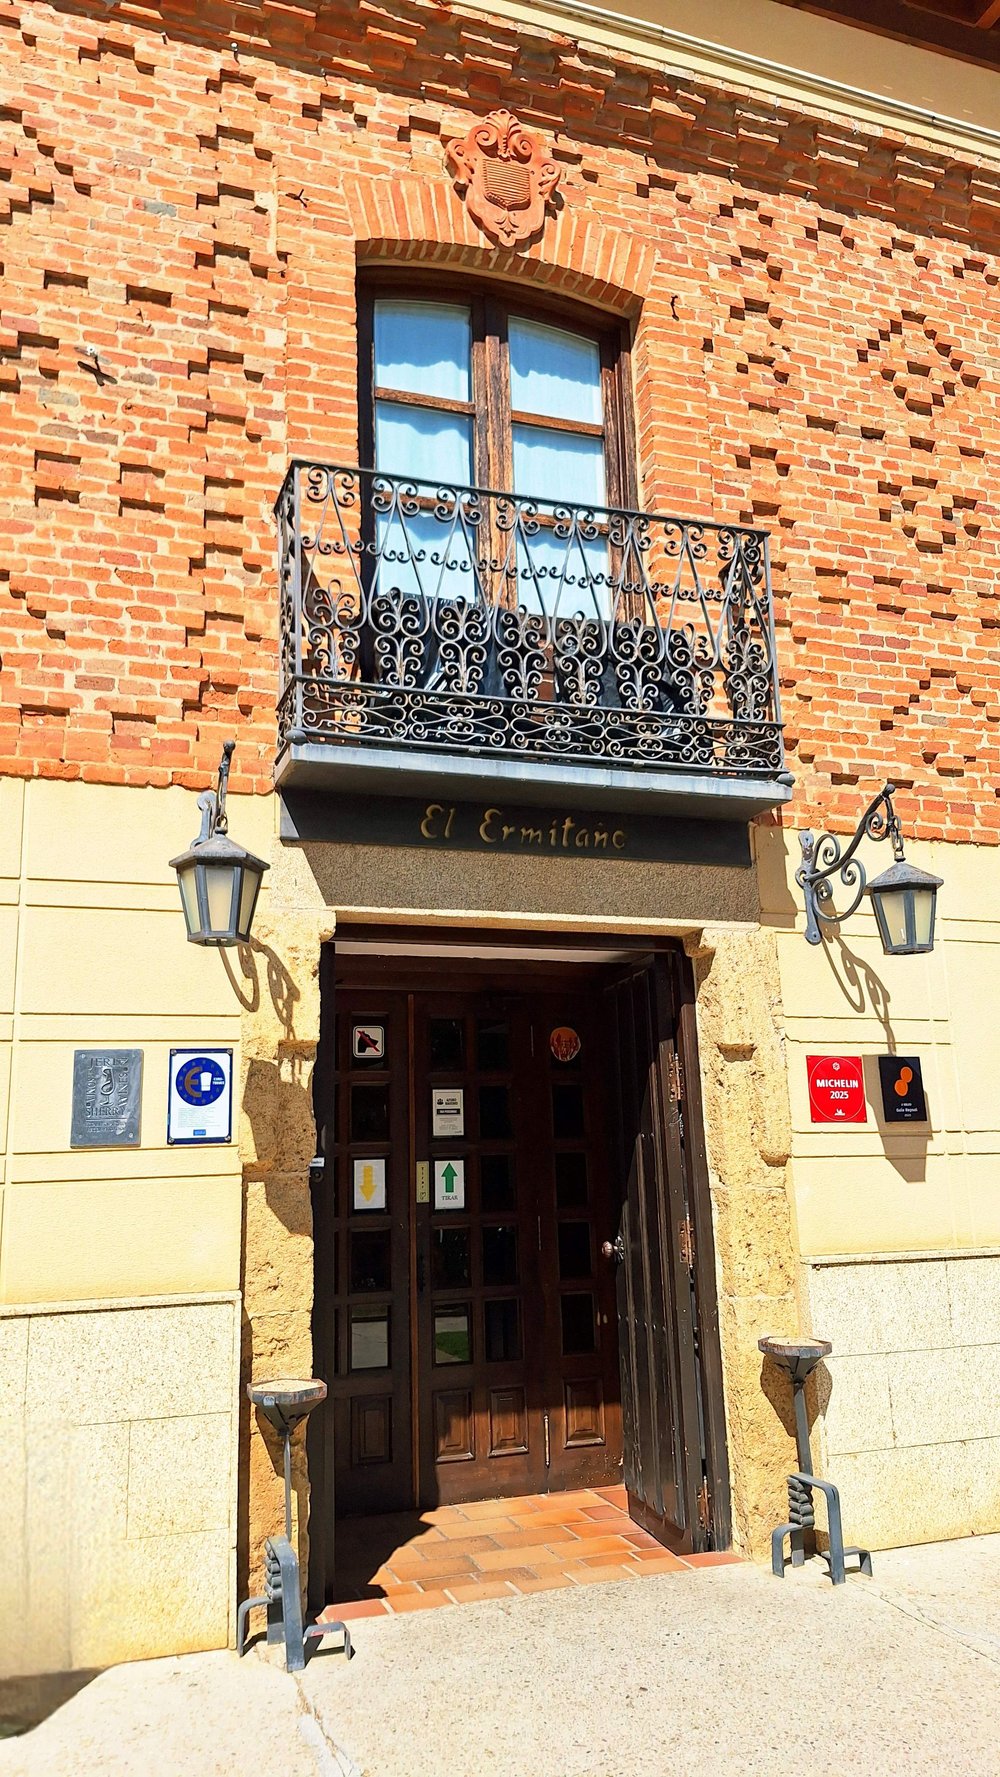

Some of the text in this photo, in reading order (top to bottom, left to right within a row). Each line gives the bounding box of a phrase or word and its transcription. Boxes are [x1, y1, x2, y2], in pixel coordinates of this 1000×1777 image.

[420, 804, 456, 840] El
[88, 1057, 129, 1070] JEREZ
[816, 1079, 859, 1088] MICHELIN
[118, 1073, 129, 1107] WINES
[830, 1090, 849, 1100] 2025
[86, 1107, 127, 1118] SHERRY
